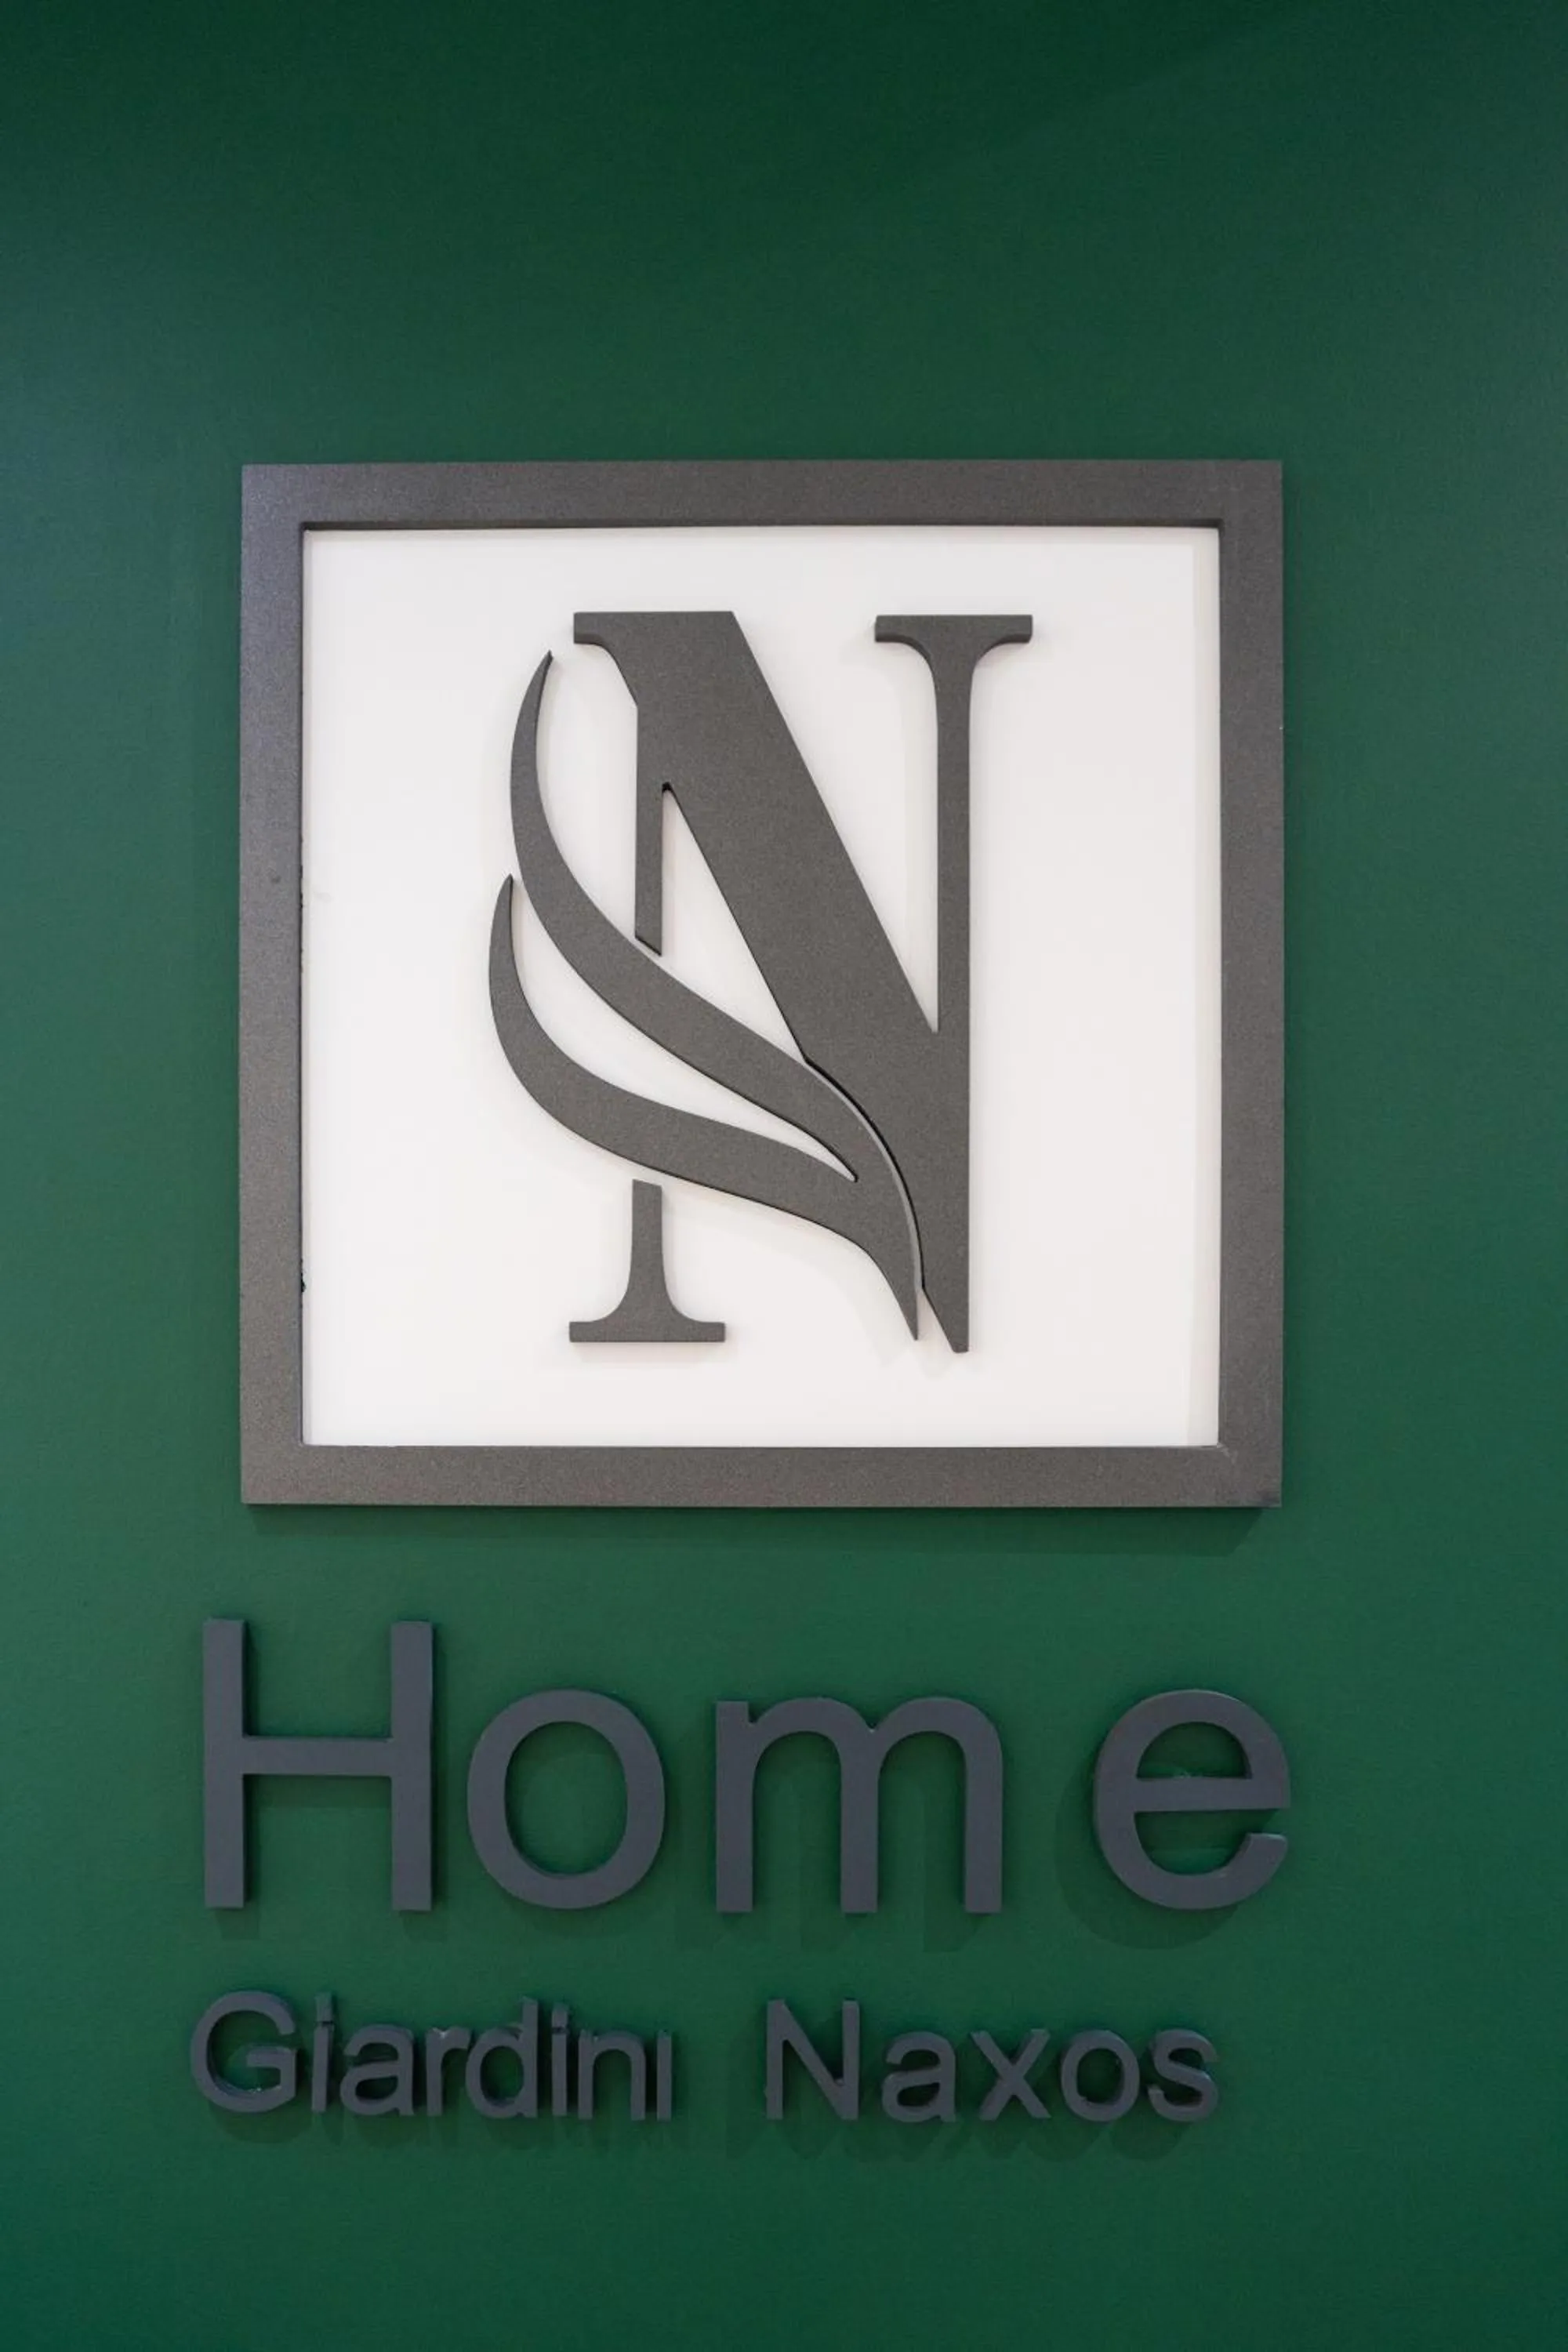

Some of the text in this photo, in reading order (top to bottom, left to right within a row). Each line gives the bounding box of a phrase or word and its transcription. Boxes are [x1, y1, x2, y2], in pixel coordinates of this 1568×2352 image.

[202, 1617, 1290, 1913] Home
[190, 1991, 1220, 2122] Giardini Naxos
